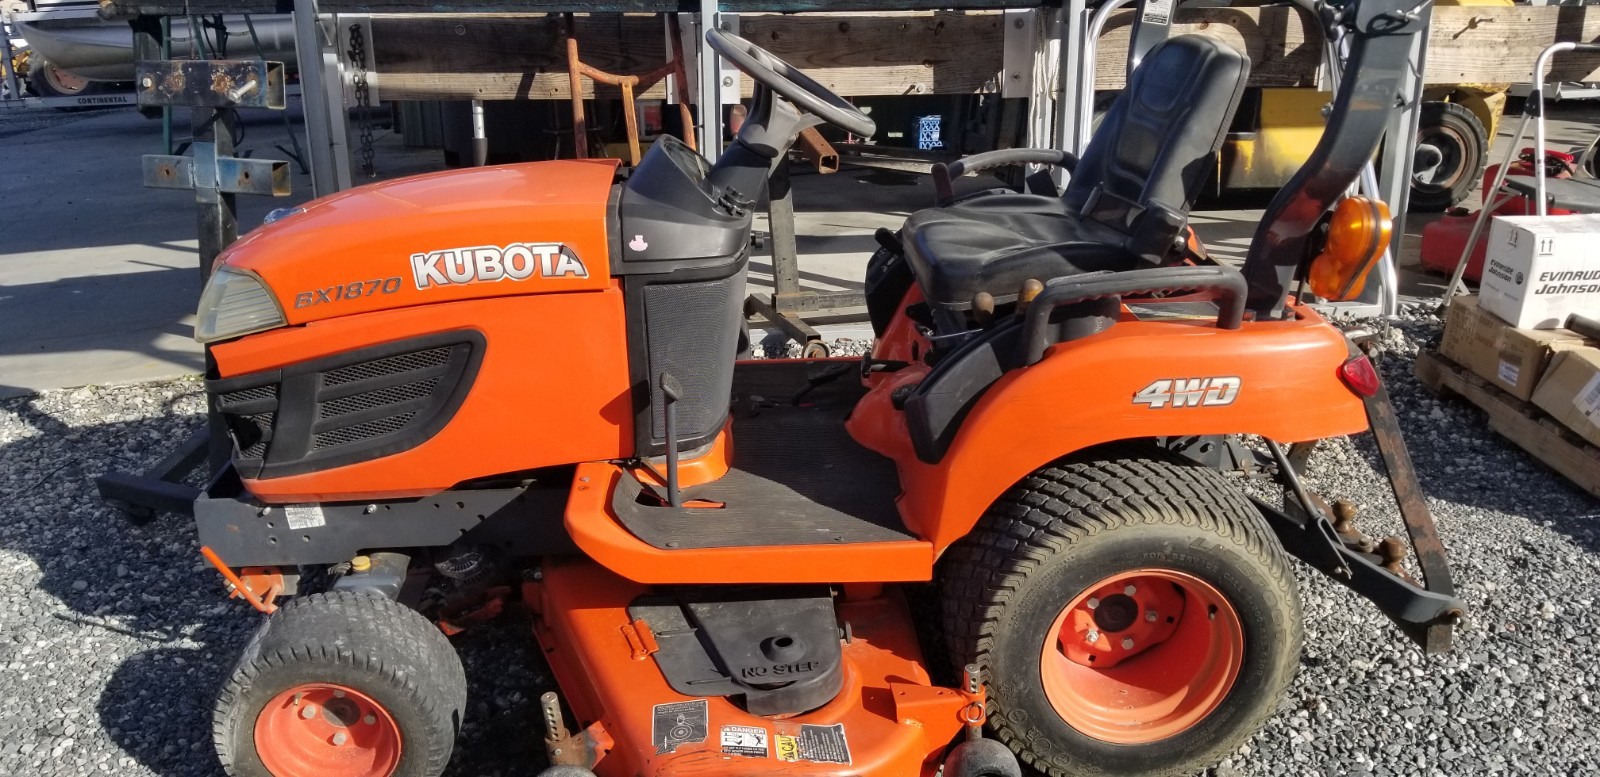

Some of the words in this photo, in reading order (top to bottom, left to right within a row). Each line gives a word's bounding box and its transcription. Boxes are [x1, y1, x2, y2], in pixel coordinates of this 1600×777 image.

[77, 96, 128, 105] CONTINENTAL
[412, 243, 588, 289] KUBOTA
[294, 277, 402, 309] BX1870
[1132, 376, 1241, 408] 4WD
[742, 666, 768, 679] NO
[772, 661, 820, 676] STEP
[731, 726, 766, 735] DANGER
